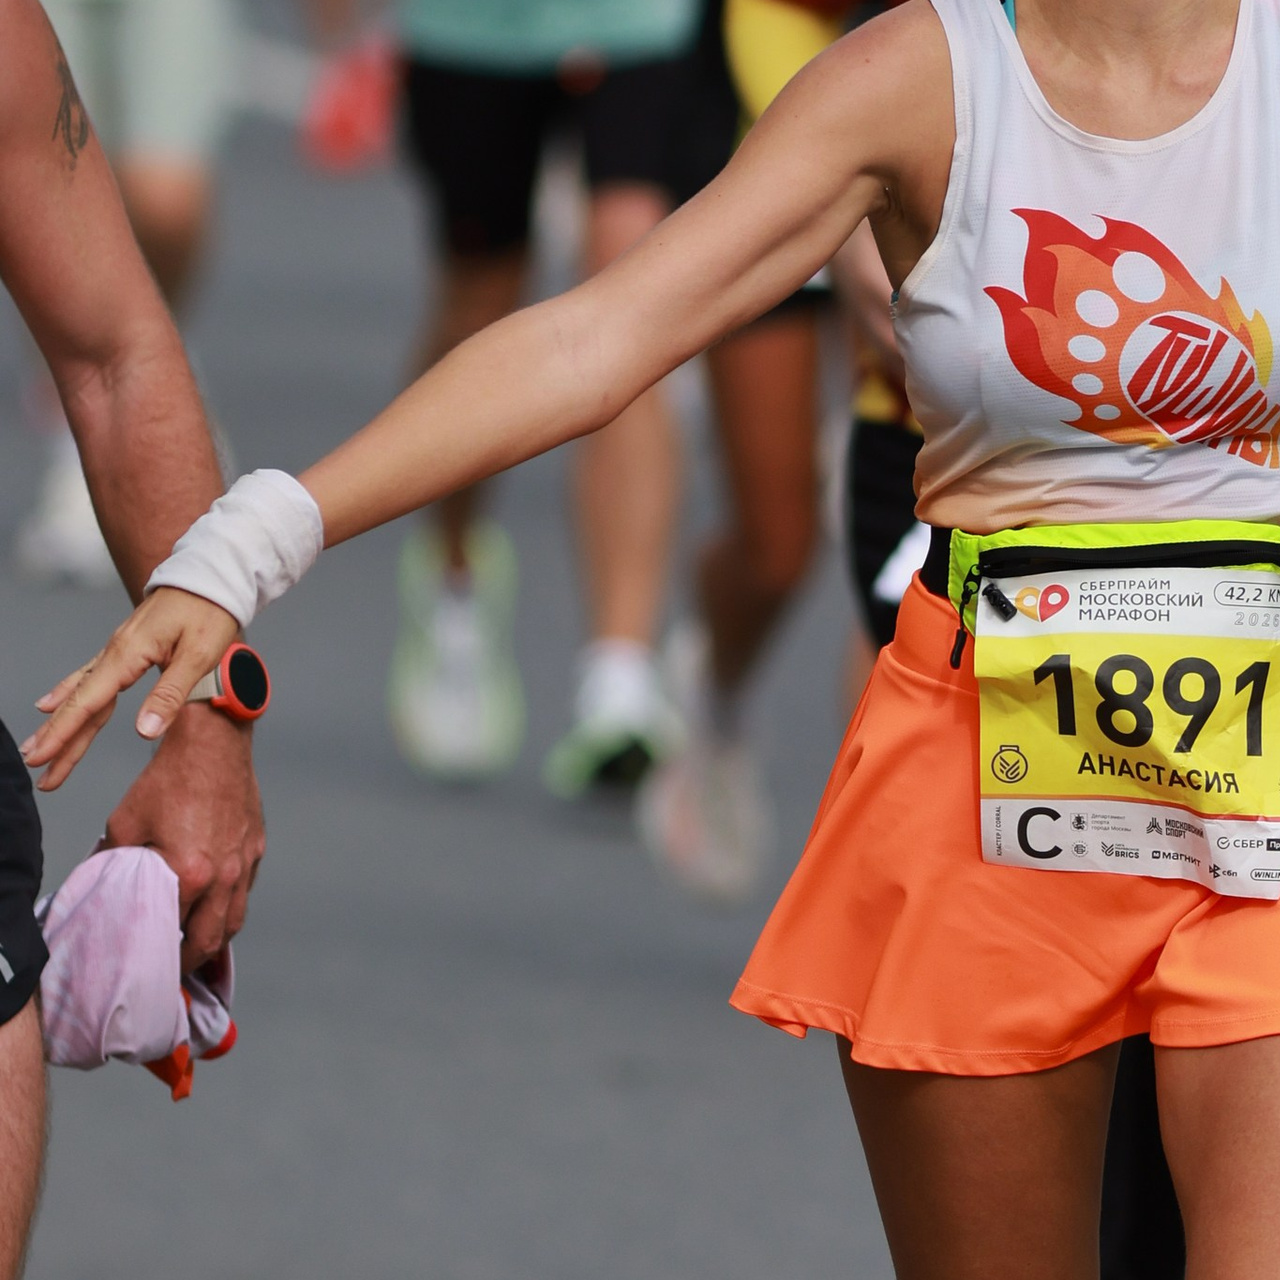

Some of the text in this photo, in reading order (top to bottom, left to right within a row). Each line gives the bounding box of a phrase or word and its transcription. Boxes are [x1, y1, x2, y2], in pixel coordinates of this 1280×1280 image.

[1079, 578, 1171, 592] СБЕРПРАЙМ
[1079, 592, 1203, 608] МОСКОВСКИЙ
[1224, 586, 1263, 604] 42,2
[1078, 608, 1171, 622] МАРАФОН
[1033, 653, 1271, 757] 1891
[1077, 752, 1240, 794] АНАСТАСИЯ
[1165, 818, 1204, 839] МОСКОВСКИЙ
[1165, 828, 1186, 839] СПОРТ
[1233, 839, 1264, 849] СБЕР
[1115, 851, 1140, 859] BRICS
[1162, 851, 1201, 867] магнит
[1222, 869, 1238, 878] сбп
